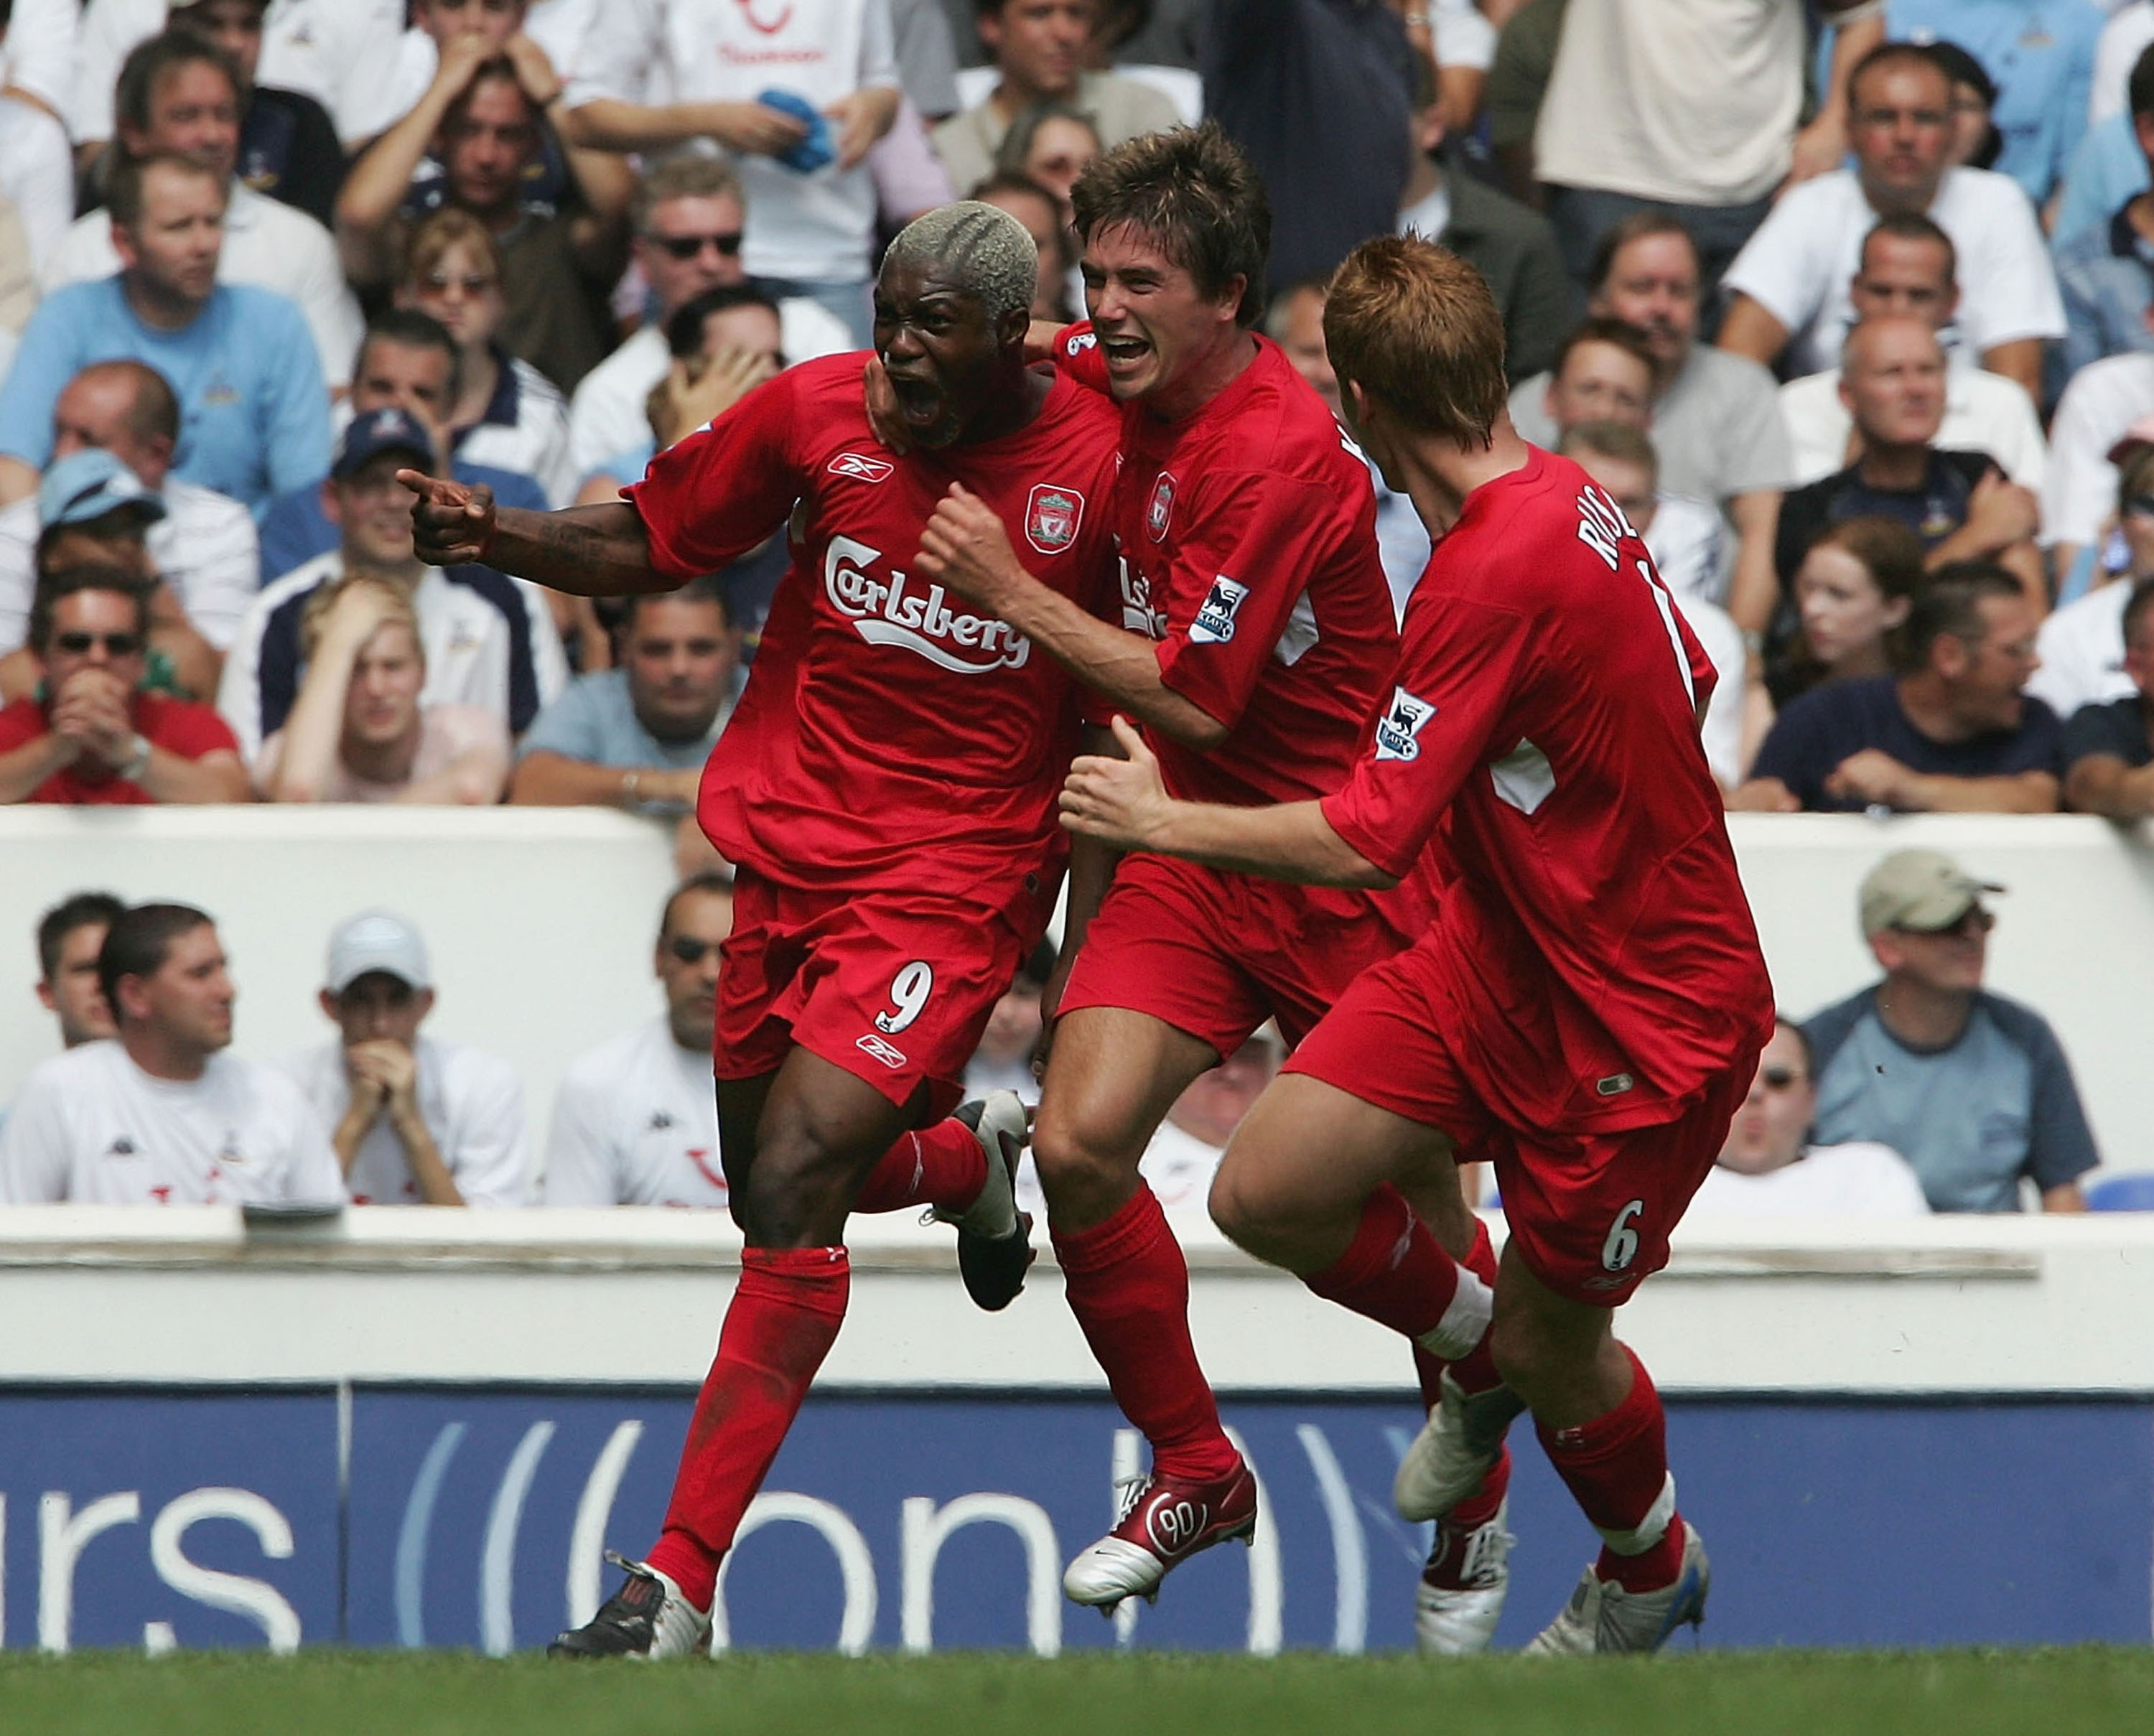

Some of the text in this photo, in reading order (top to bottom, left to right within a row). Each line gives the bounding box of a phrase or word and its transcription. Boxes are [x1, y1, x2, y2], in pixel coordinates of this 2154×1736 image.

[825, 534, 1030, 668] Carlsberg
[875, 960, 933, 1033] 9
[1602, 1199, 1644, 1271] 6
[1159, 1501, 1195, 1544] 90
